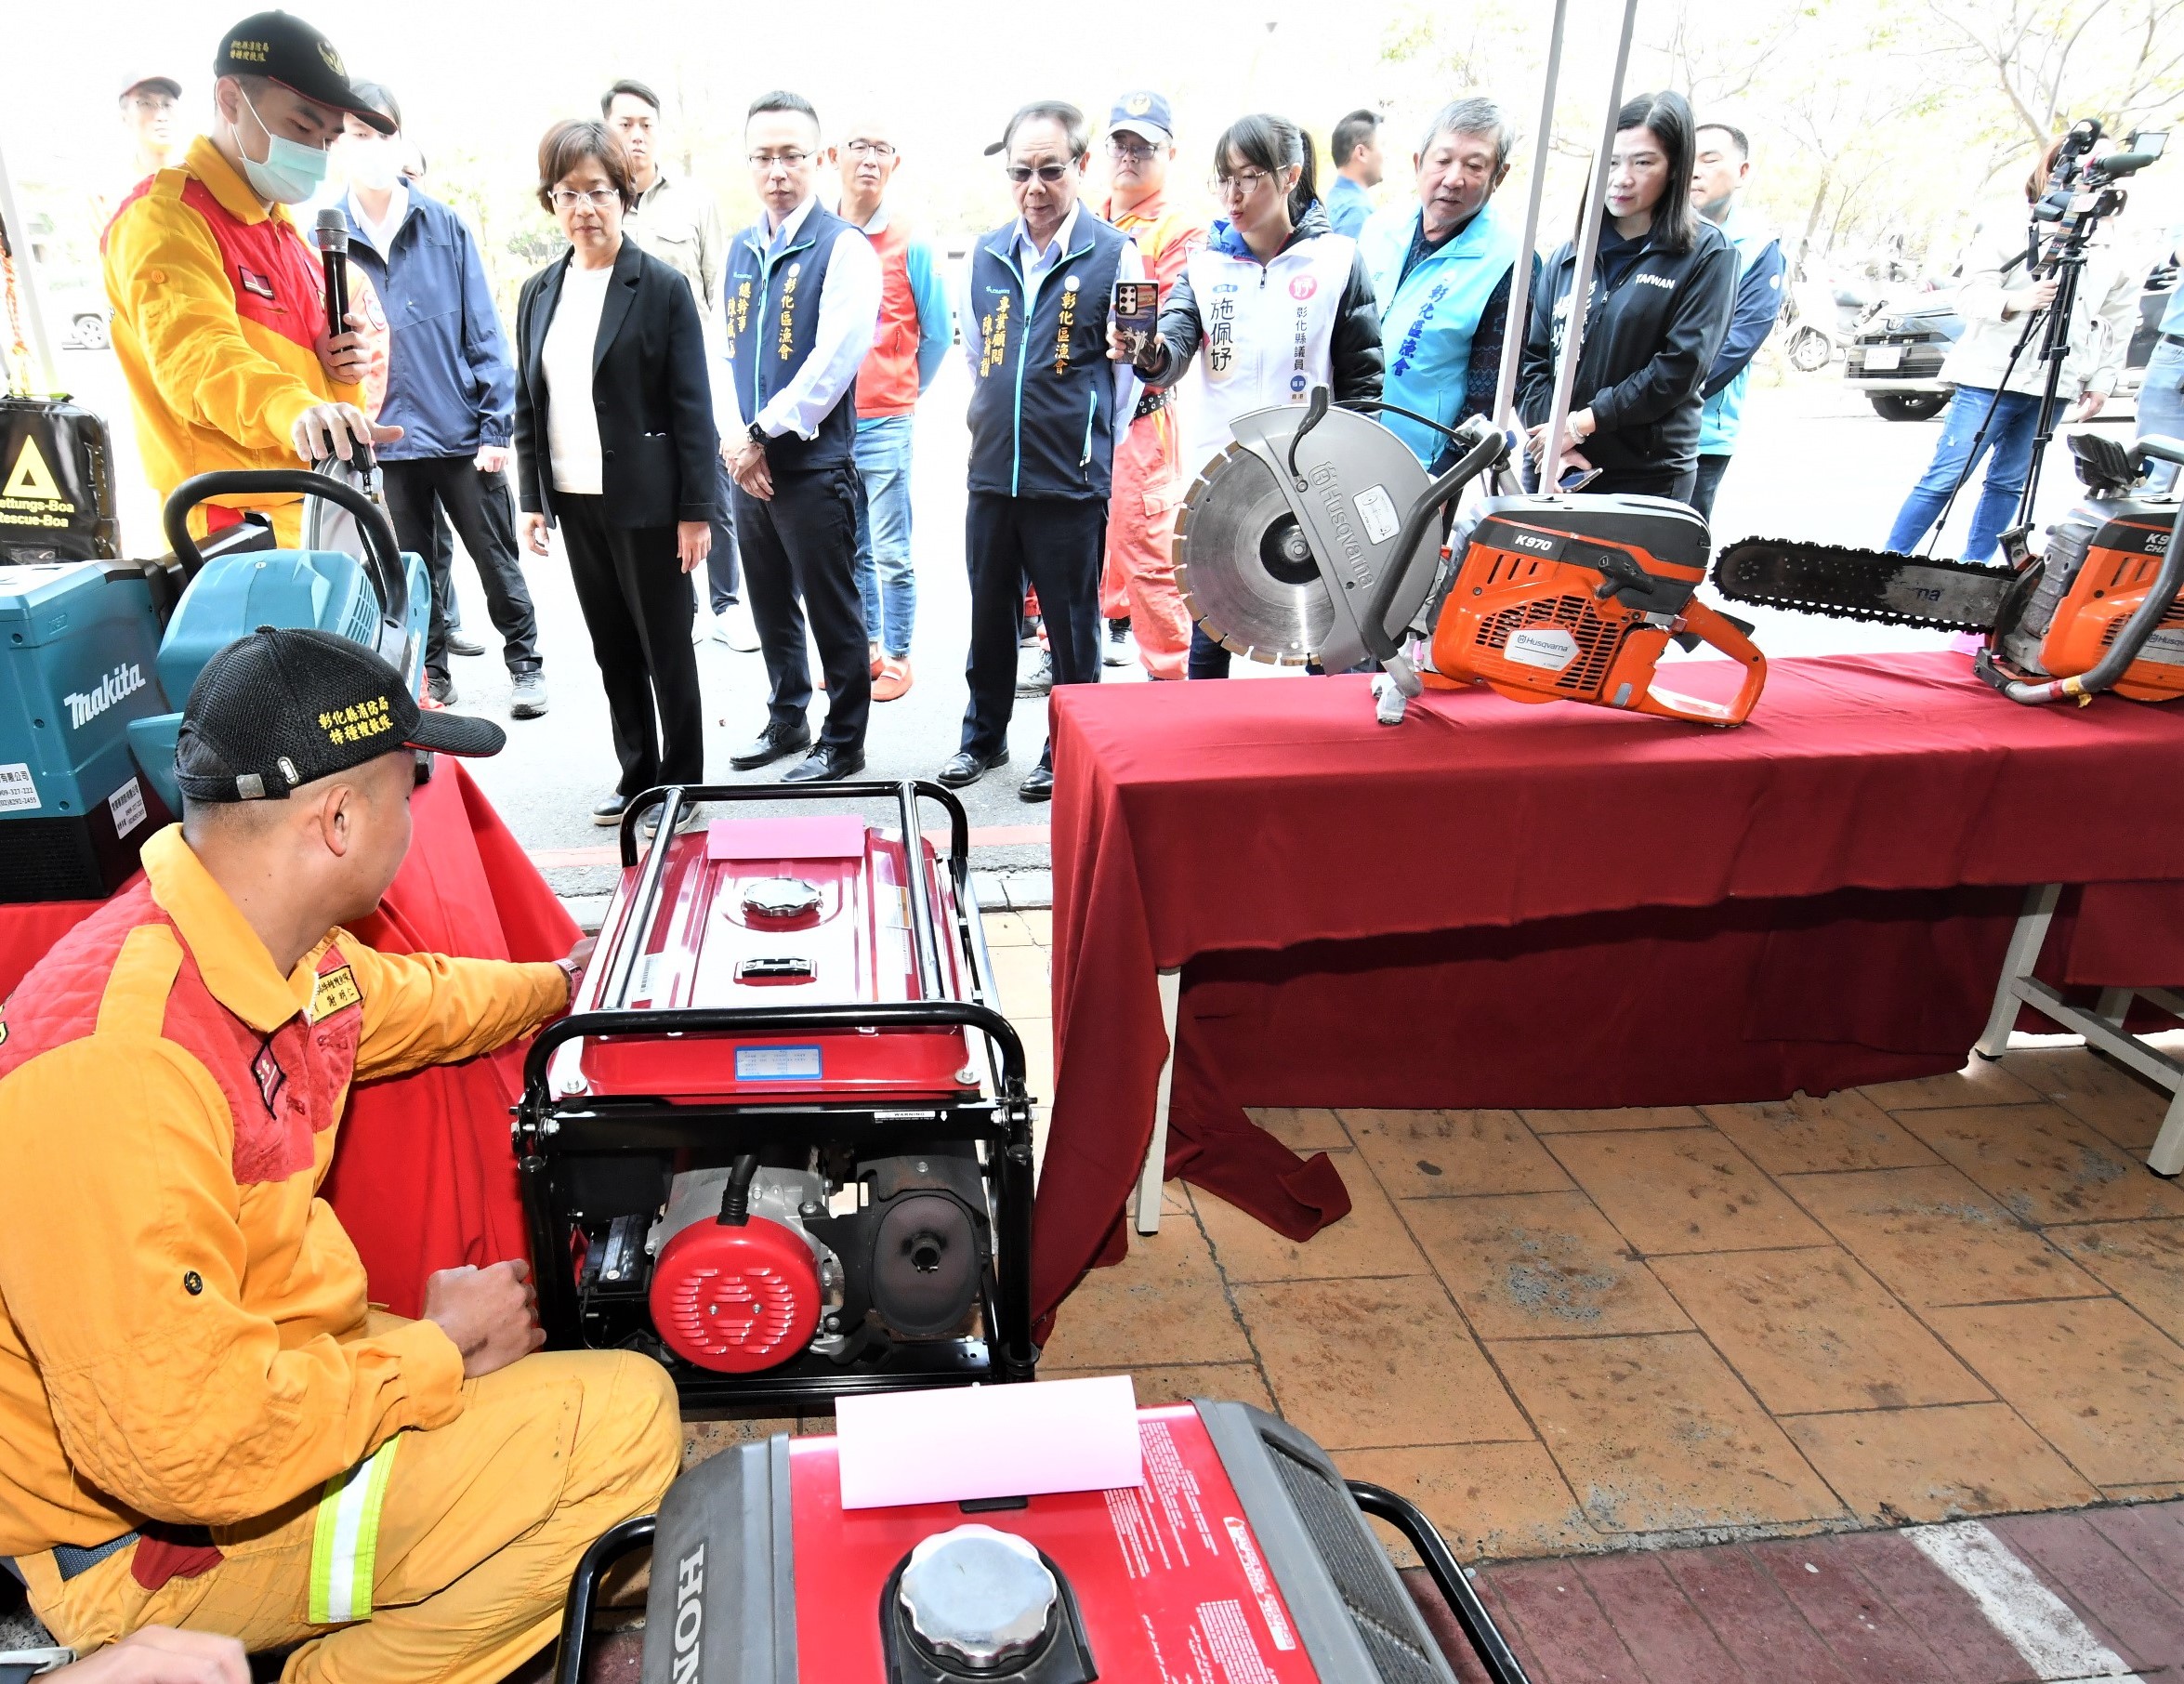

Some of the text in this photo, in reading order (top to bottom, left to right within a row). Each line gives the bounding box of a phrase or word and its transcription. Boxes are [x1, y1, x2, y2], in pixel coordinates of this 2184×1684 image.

[737, 282, 752, 333] 總幹事
[1636, 273, 1676, 289] TAIWAN
[778, 277, 797, 361] 彰化區漁會
[991, 296, 1010, 366] 專業顧問
[1053, 291, 1077, 375] 彰化區漁會
[1210, 297, 1235, 372] 施佩妤
[1293, 307, 1308, 371] 彰化縣議員
[1392, 284, 1449, 376] 彰化區漁會
[1318, 483, 1375, 590] Husqvarna
[1515, 534, 1553, 551] K970
[1526, 635, 1568, 652] Husqvarna
[318, 696, 388, 730] 彰化縣消防局
[329, 713, 394, 744] 特種搜救隊
